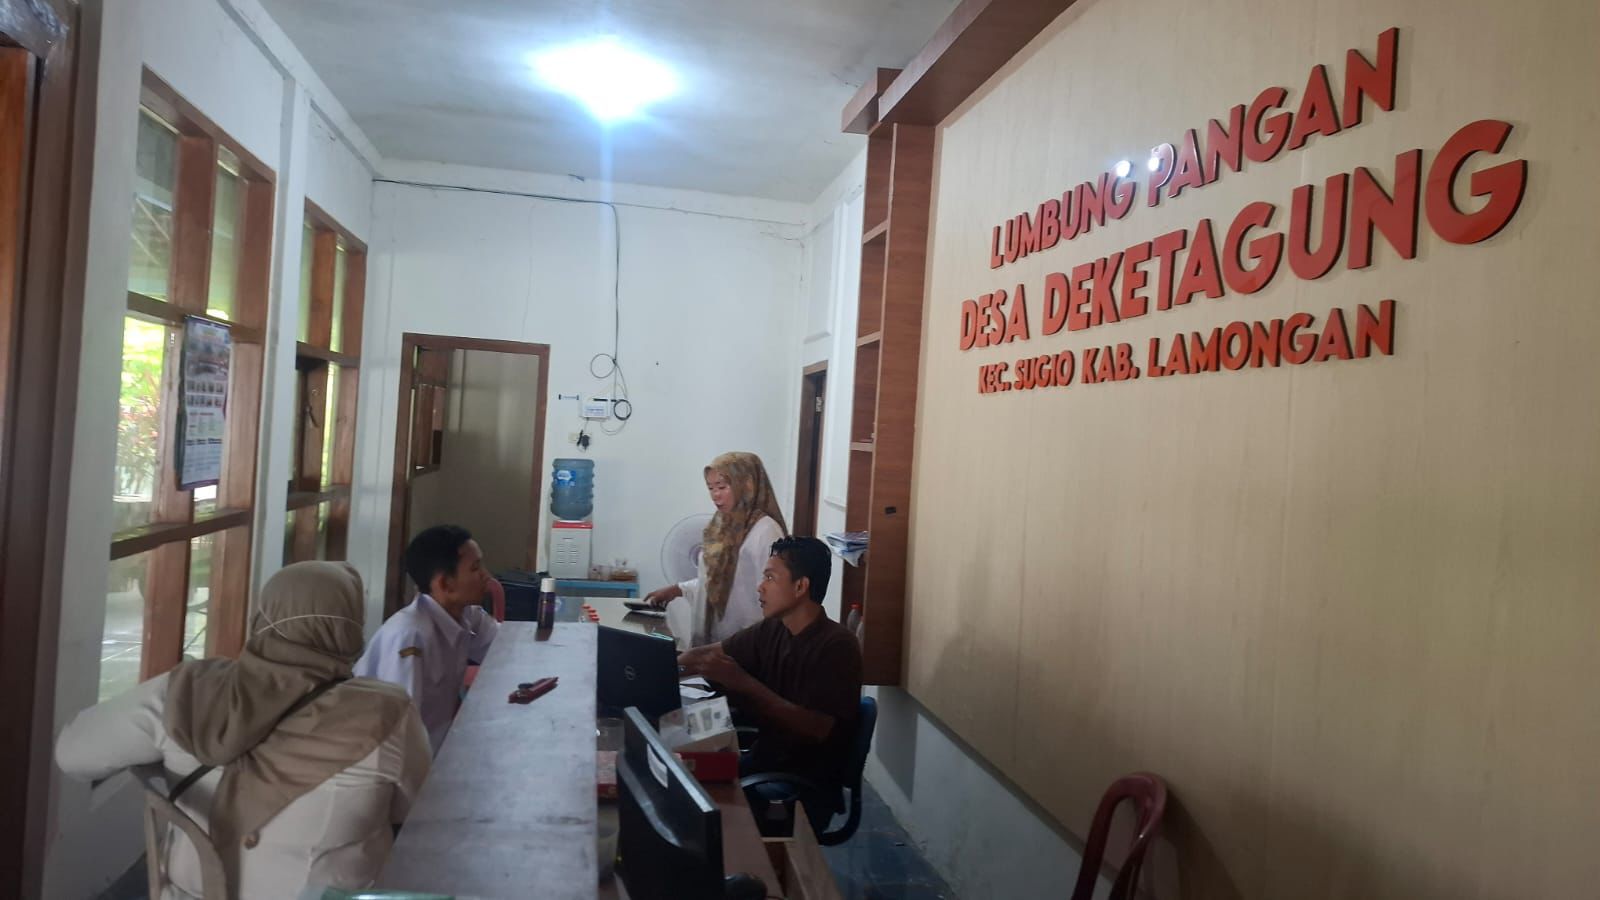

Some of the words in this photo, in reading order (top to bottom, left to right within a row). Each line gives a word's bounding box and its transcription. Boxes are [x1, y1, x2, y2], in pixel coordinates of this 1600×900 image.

[959, 284, 1030, 351] DESA
[1042, 119, 1528, 336] DEKETAGUNG
[990, 161, 1136, 268] LUMBUNG
[1148, 27, 1399, 206] PANGAN
[978, 360, 1011, 394] KEC.
[1014, 350, 1075, 390] SUGIO
[1081, 345, 1140, 384] KAB.
[1147, 299, 1397, 378] LAMONGAN
